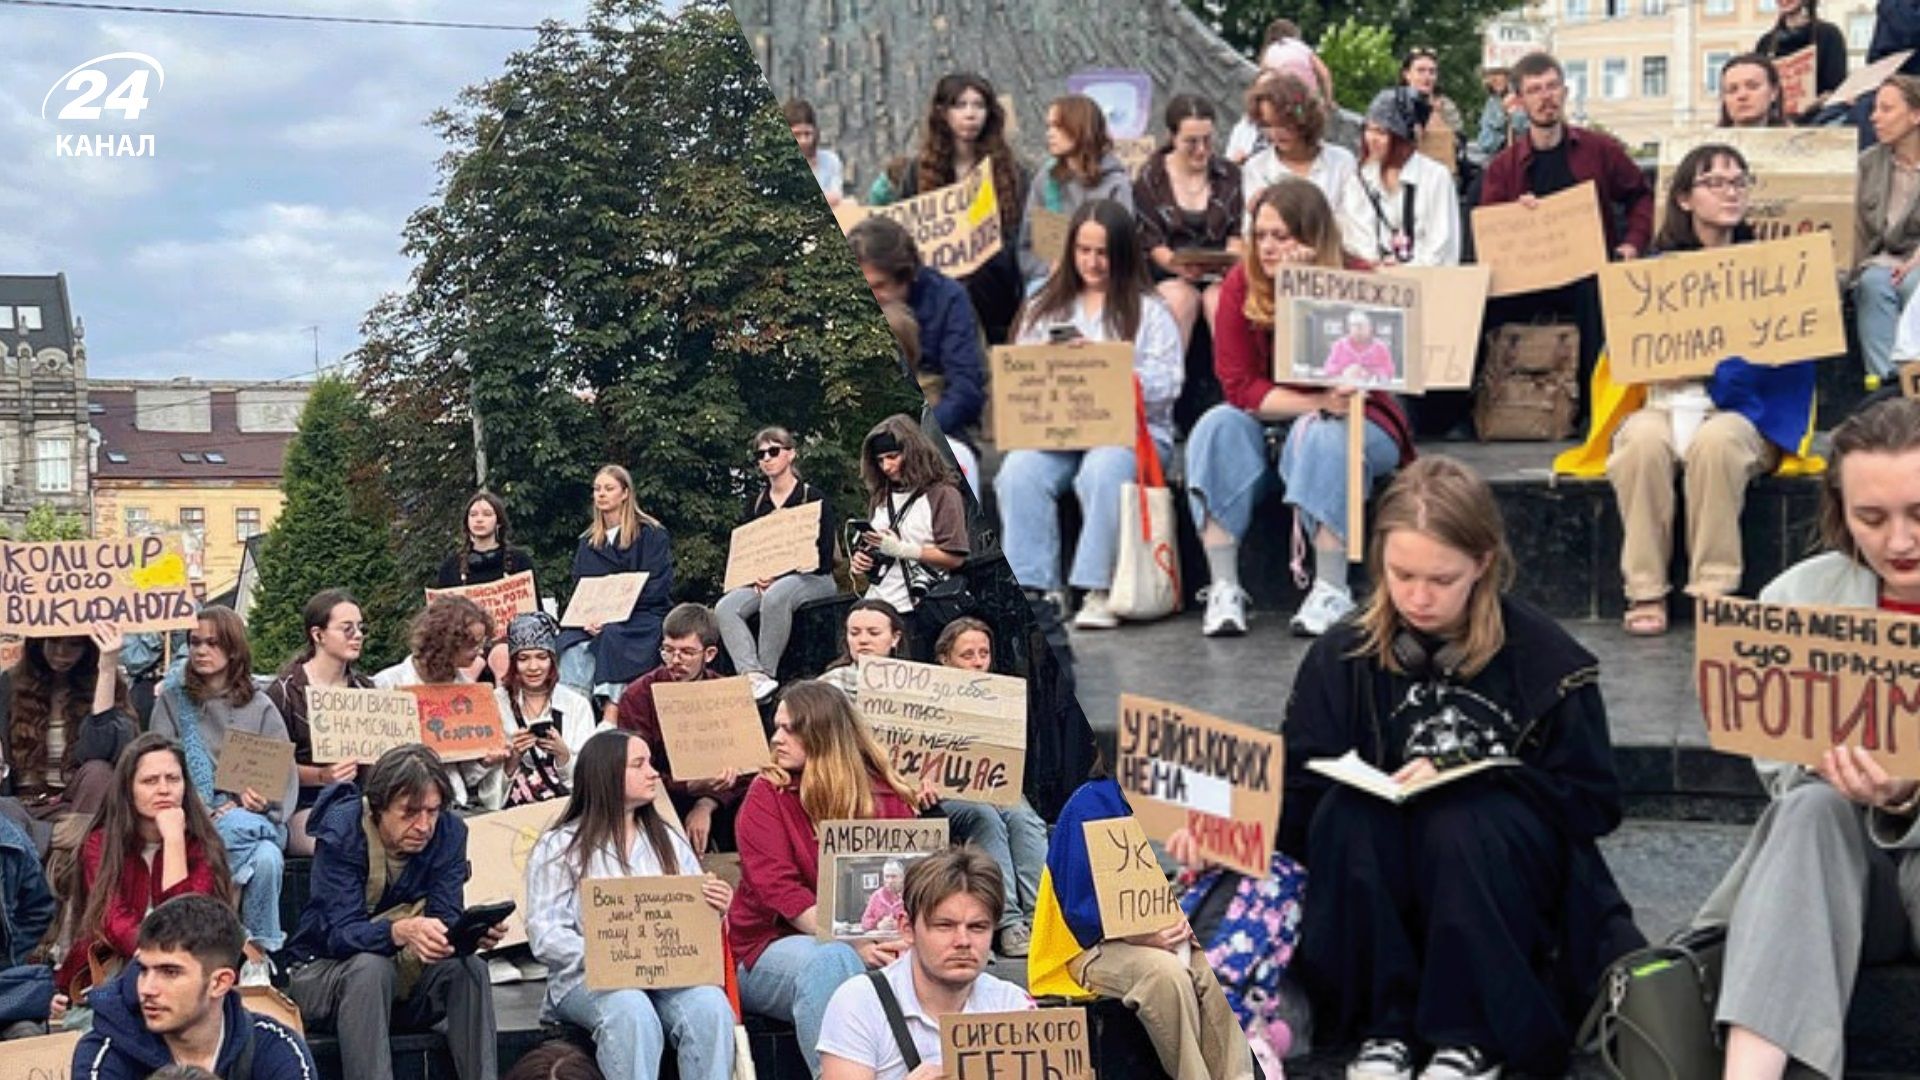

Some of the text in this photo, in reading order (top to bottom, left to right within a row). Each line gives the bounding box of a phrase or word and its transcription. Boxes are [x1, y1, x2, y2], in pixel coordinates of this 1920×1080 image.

[1625, 251, 1807, 316] УКРАЇНЦІ
[1749, 309, 1818, 347] УСЕ
[4, 537, 163, 576] КОЛИ СИР
[7, 590, 194, 627] ВИКИДАЮТЬ
[1702, 600, 1804, 636] НАХІБА
[1808, 612, 1878, 646] МЕНІ
[863, 661, 931, 690] СТОЮ
[311, 692, 416, 717] ВОВКИ ВИЮТЬ
[863, 698, 897, 715] та
[333, 717, 352, 733] НА
[316, 739, 333, 758] НЕ
[1124, 708, 1273, 792] У ВІЙСЬКОВИХ
[889, 744, 1008, 793] АХИЩАЄ
[1123, 756, 1189, 804] НЕМА
[824, 825, 918, 854] АМБРИДЖ
[593, 886, 625, 908] Вони
[952, 1020, 1082, 1048] СИРСЬКОГО
